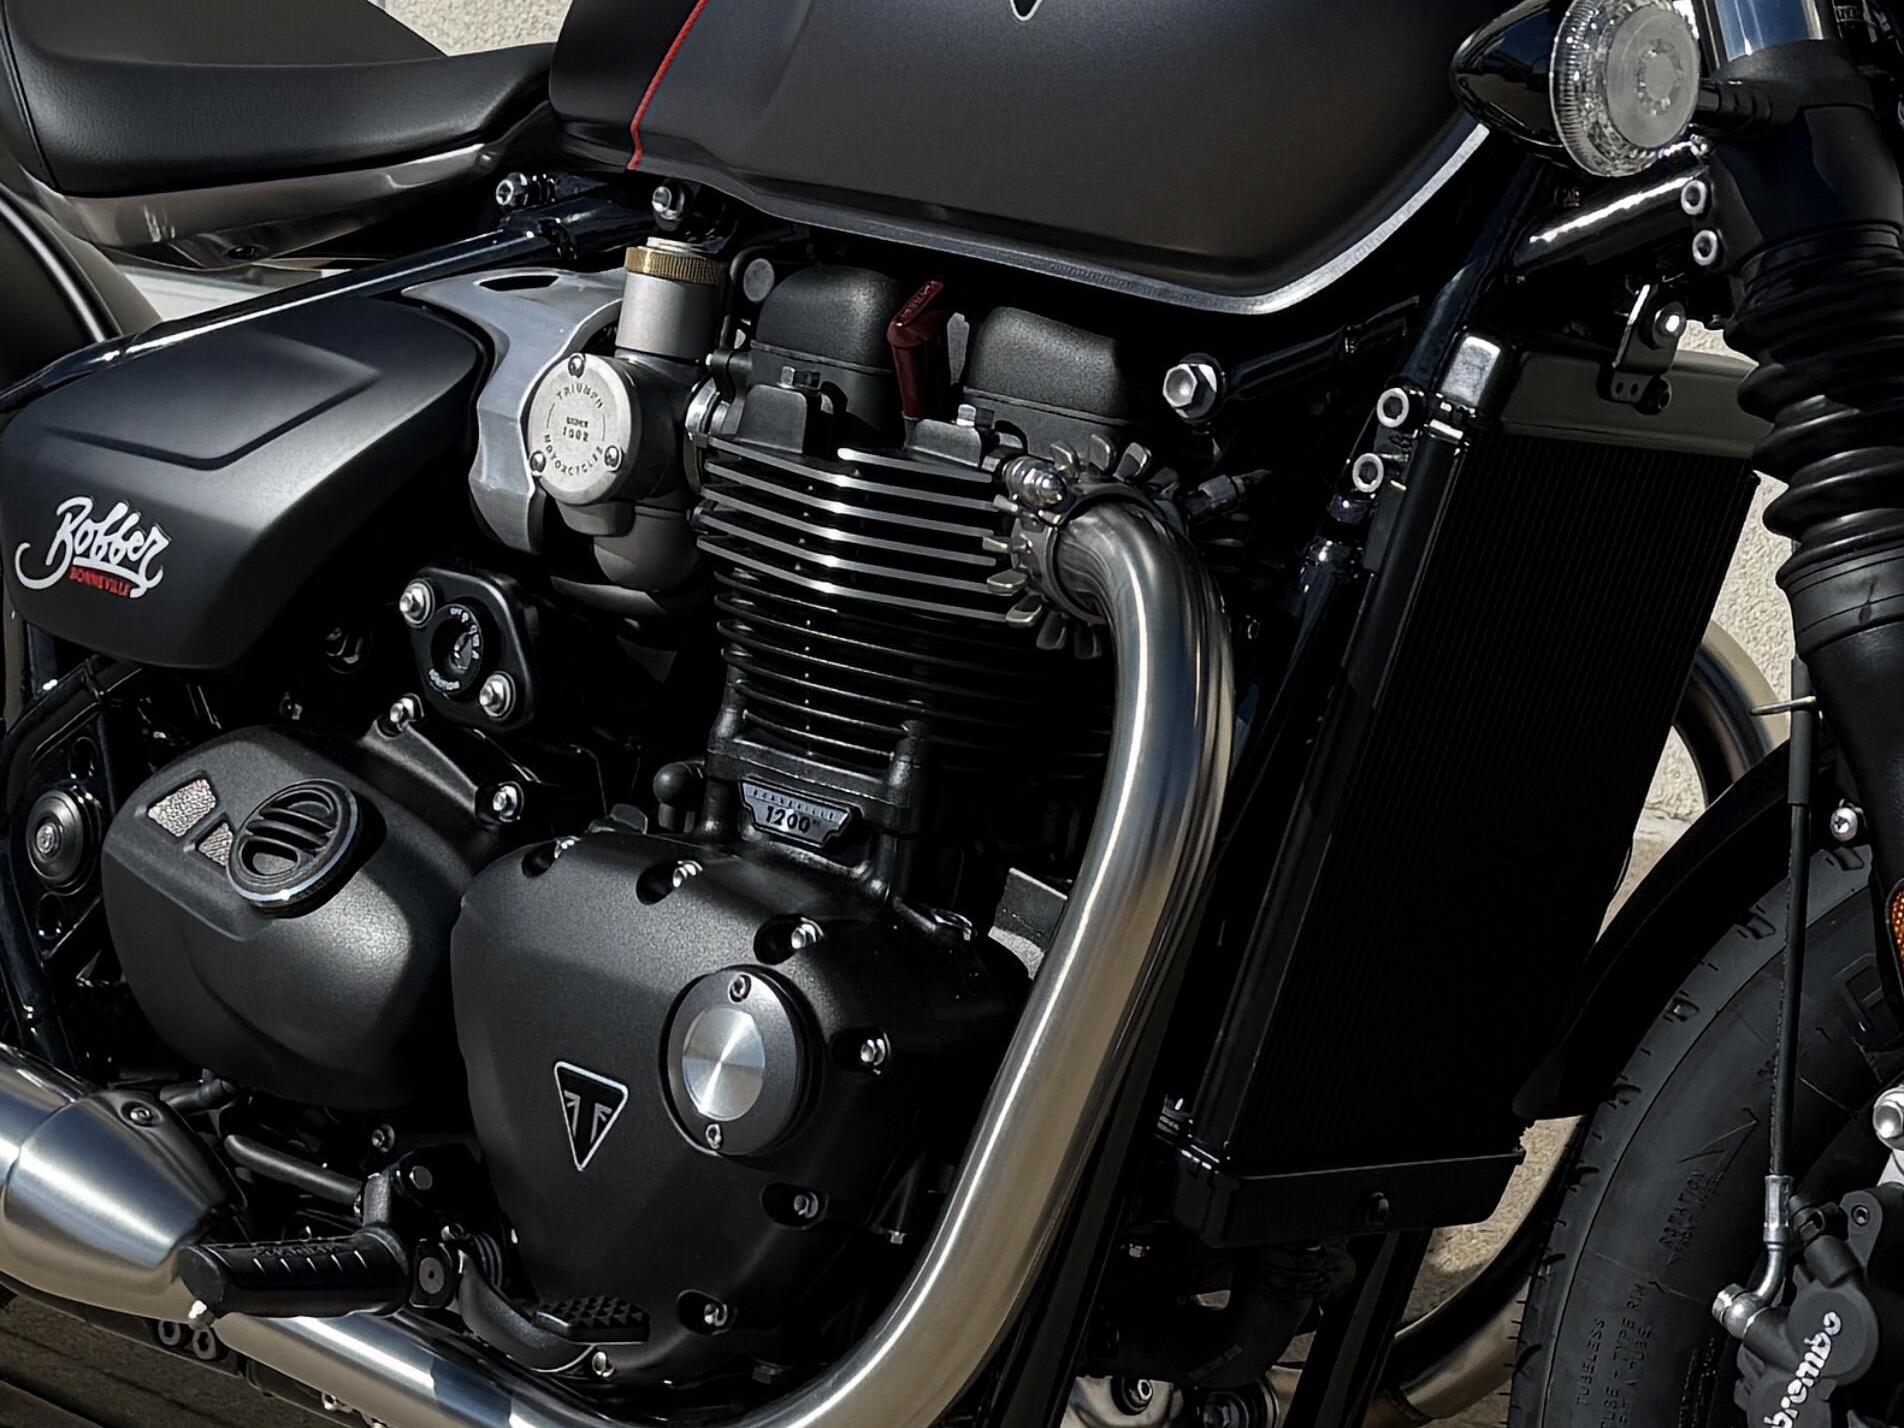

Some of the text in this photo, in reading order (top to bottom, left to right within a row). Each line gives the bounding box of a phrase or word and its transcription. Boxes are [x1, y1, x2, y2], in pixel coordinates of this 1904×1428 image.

[554, 381, 605, 411] TRIUMPH
[14, 495, 172, 599] Bobber
[1575, 1317, 1606, 1406] TUBELESS
